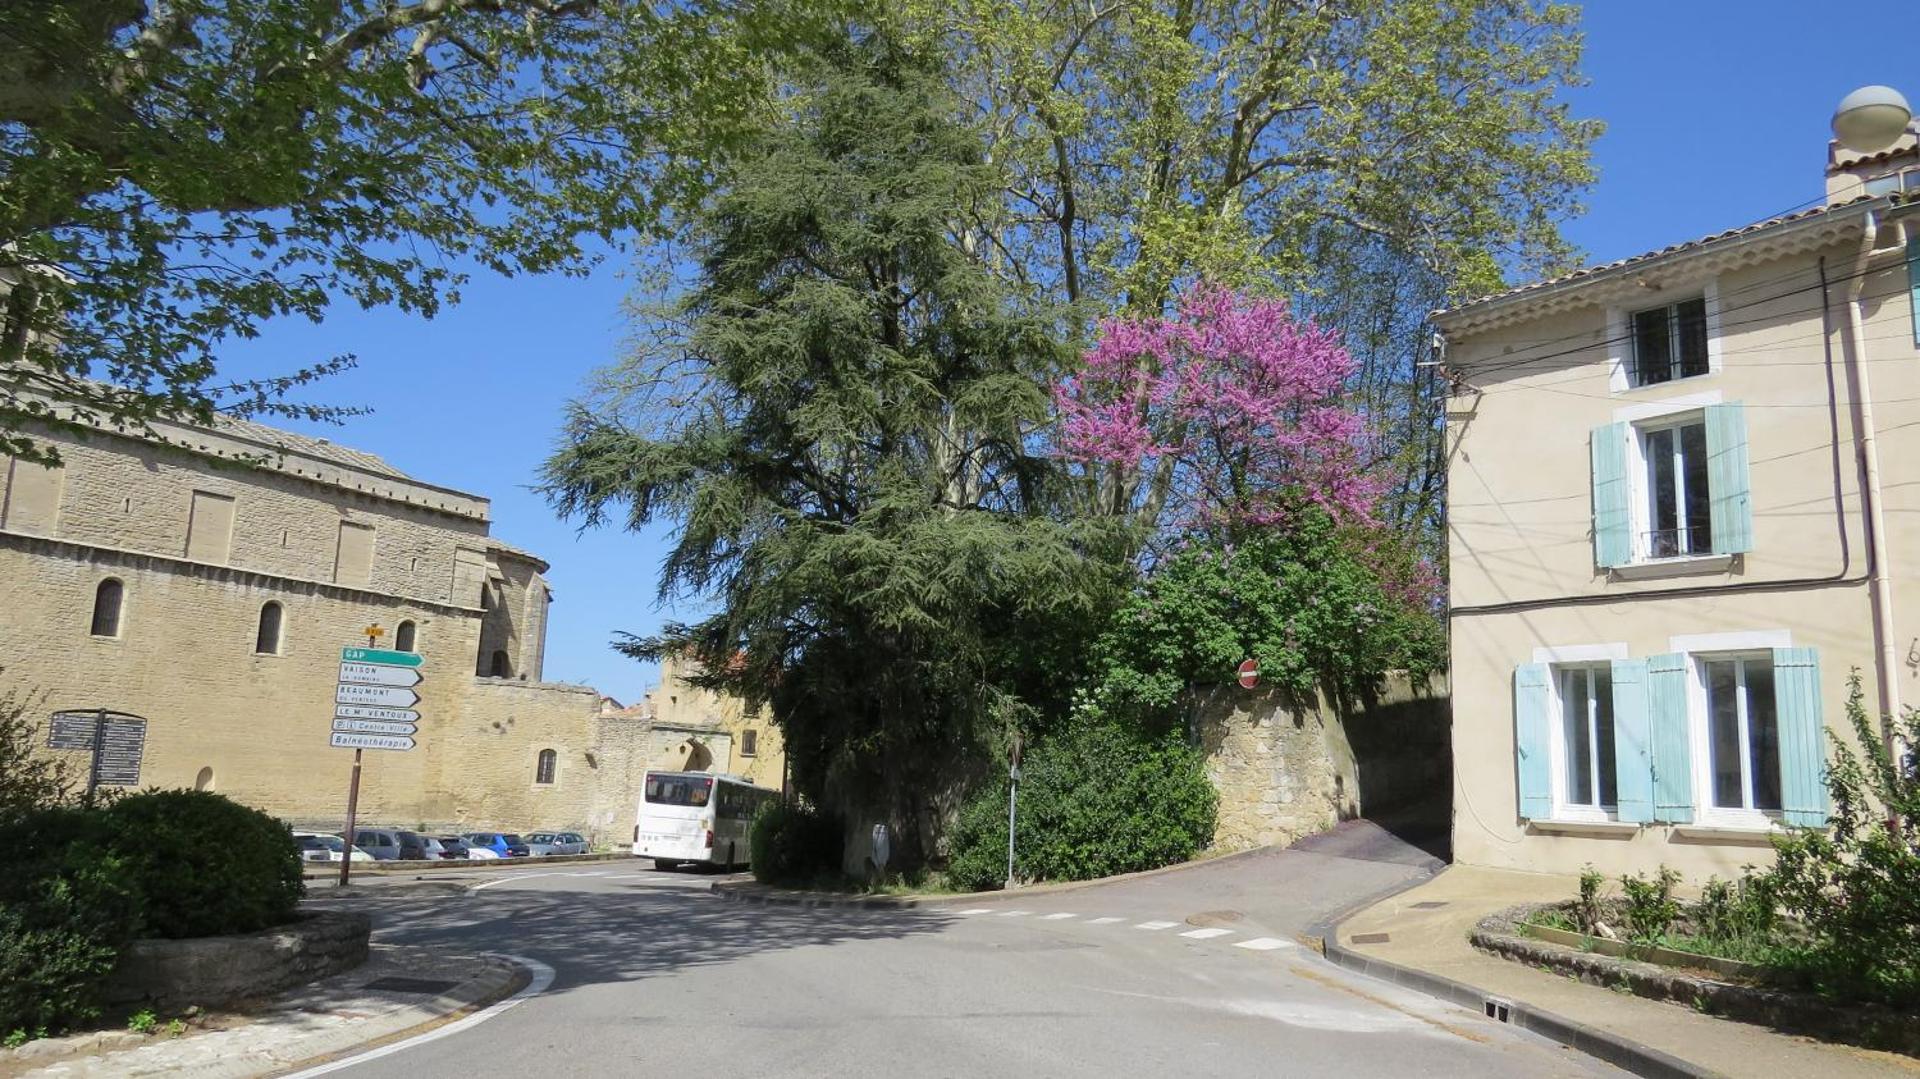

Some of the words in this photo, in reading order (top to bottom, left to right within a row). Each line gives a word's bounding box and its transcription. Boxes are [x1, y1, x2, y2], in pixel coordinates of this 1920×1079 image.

[345, 650, 365, 658] GAP
[344, 666, 377, 674] VAISON
[340, 686, 389, 696] BEAUMONT
[368, 710, 407, 719] VENTOUX
[359, 723, 385, 731] Centre
[336, 736, 408, 747] Balnéothérapie
